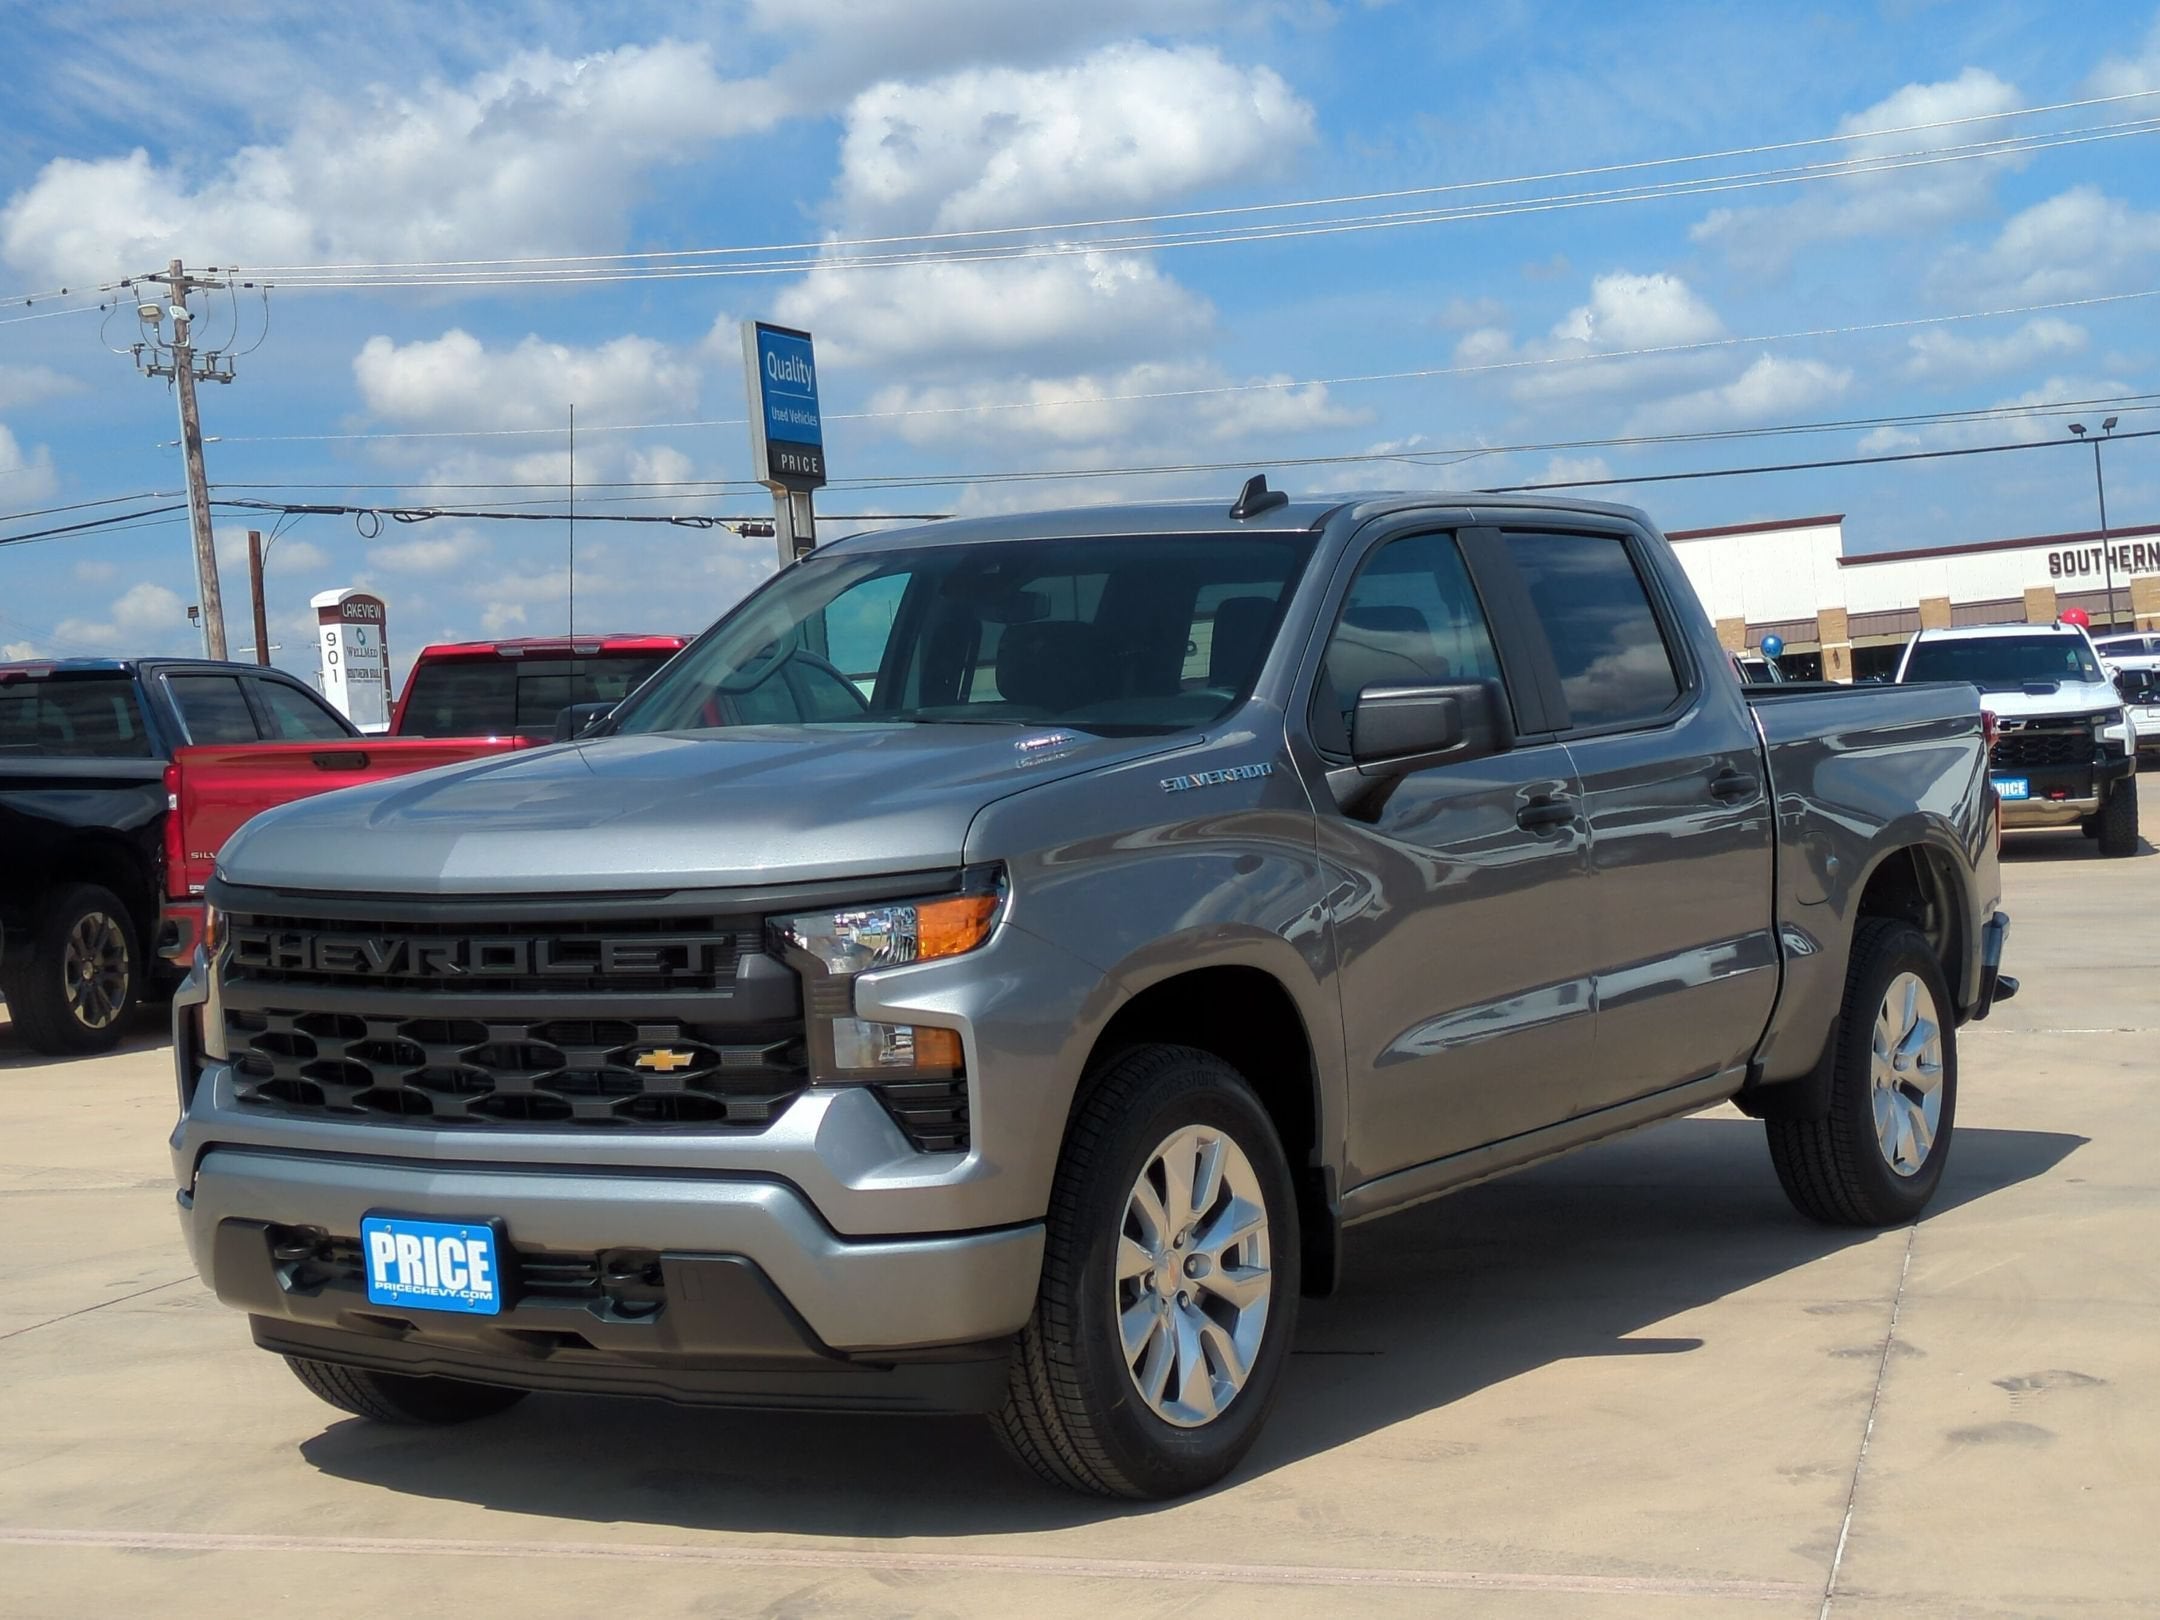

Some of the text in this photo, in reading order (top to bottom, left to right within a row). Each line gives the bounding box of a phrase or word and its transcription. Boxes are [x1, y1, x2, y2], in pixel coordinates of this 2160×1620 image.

[767, 351, 812, 392] Quality
[771, 406, 818, 427] Used Vehicles
[781, 454, 818, 473] PRICE
[2048, 542, 2160, 576] SOUTHERN
[342, 602, 381, 619] LAKEVIEW
[326, 632, 339, 683] 901
[1160, 762, 1274, 792] SILVERADO
[1993, 781, 2026, 796] RICE
[232, 931, 730, 976] CHEVROLET
[370, 1231, 492, 1291] PRICE
[374, 1282, 493, 1300] PRICECHEVY.COM
